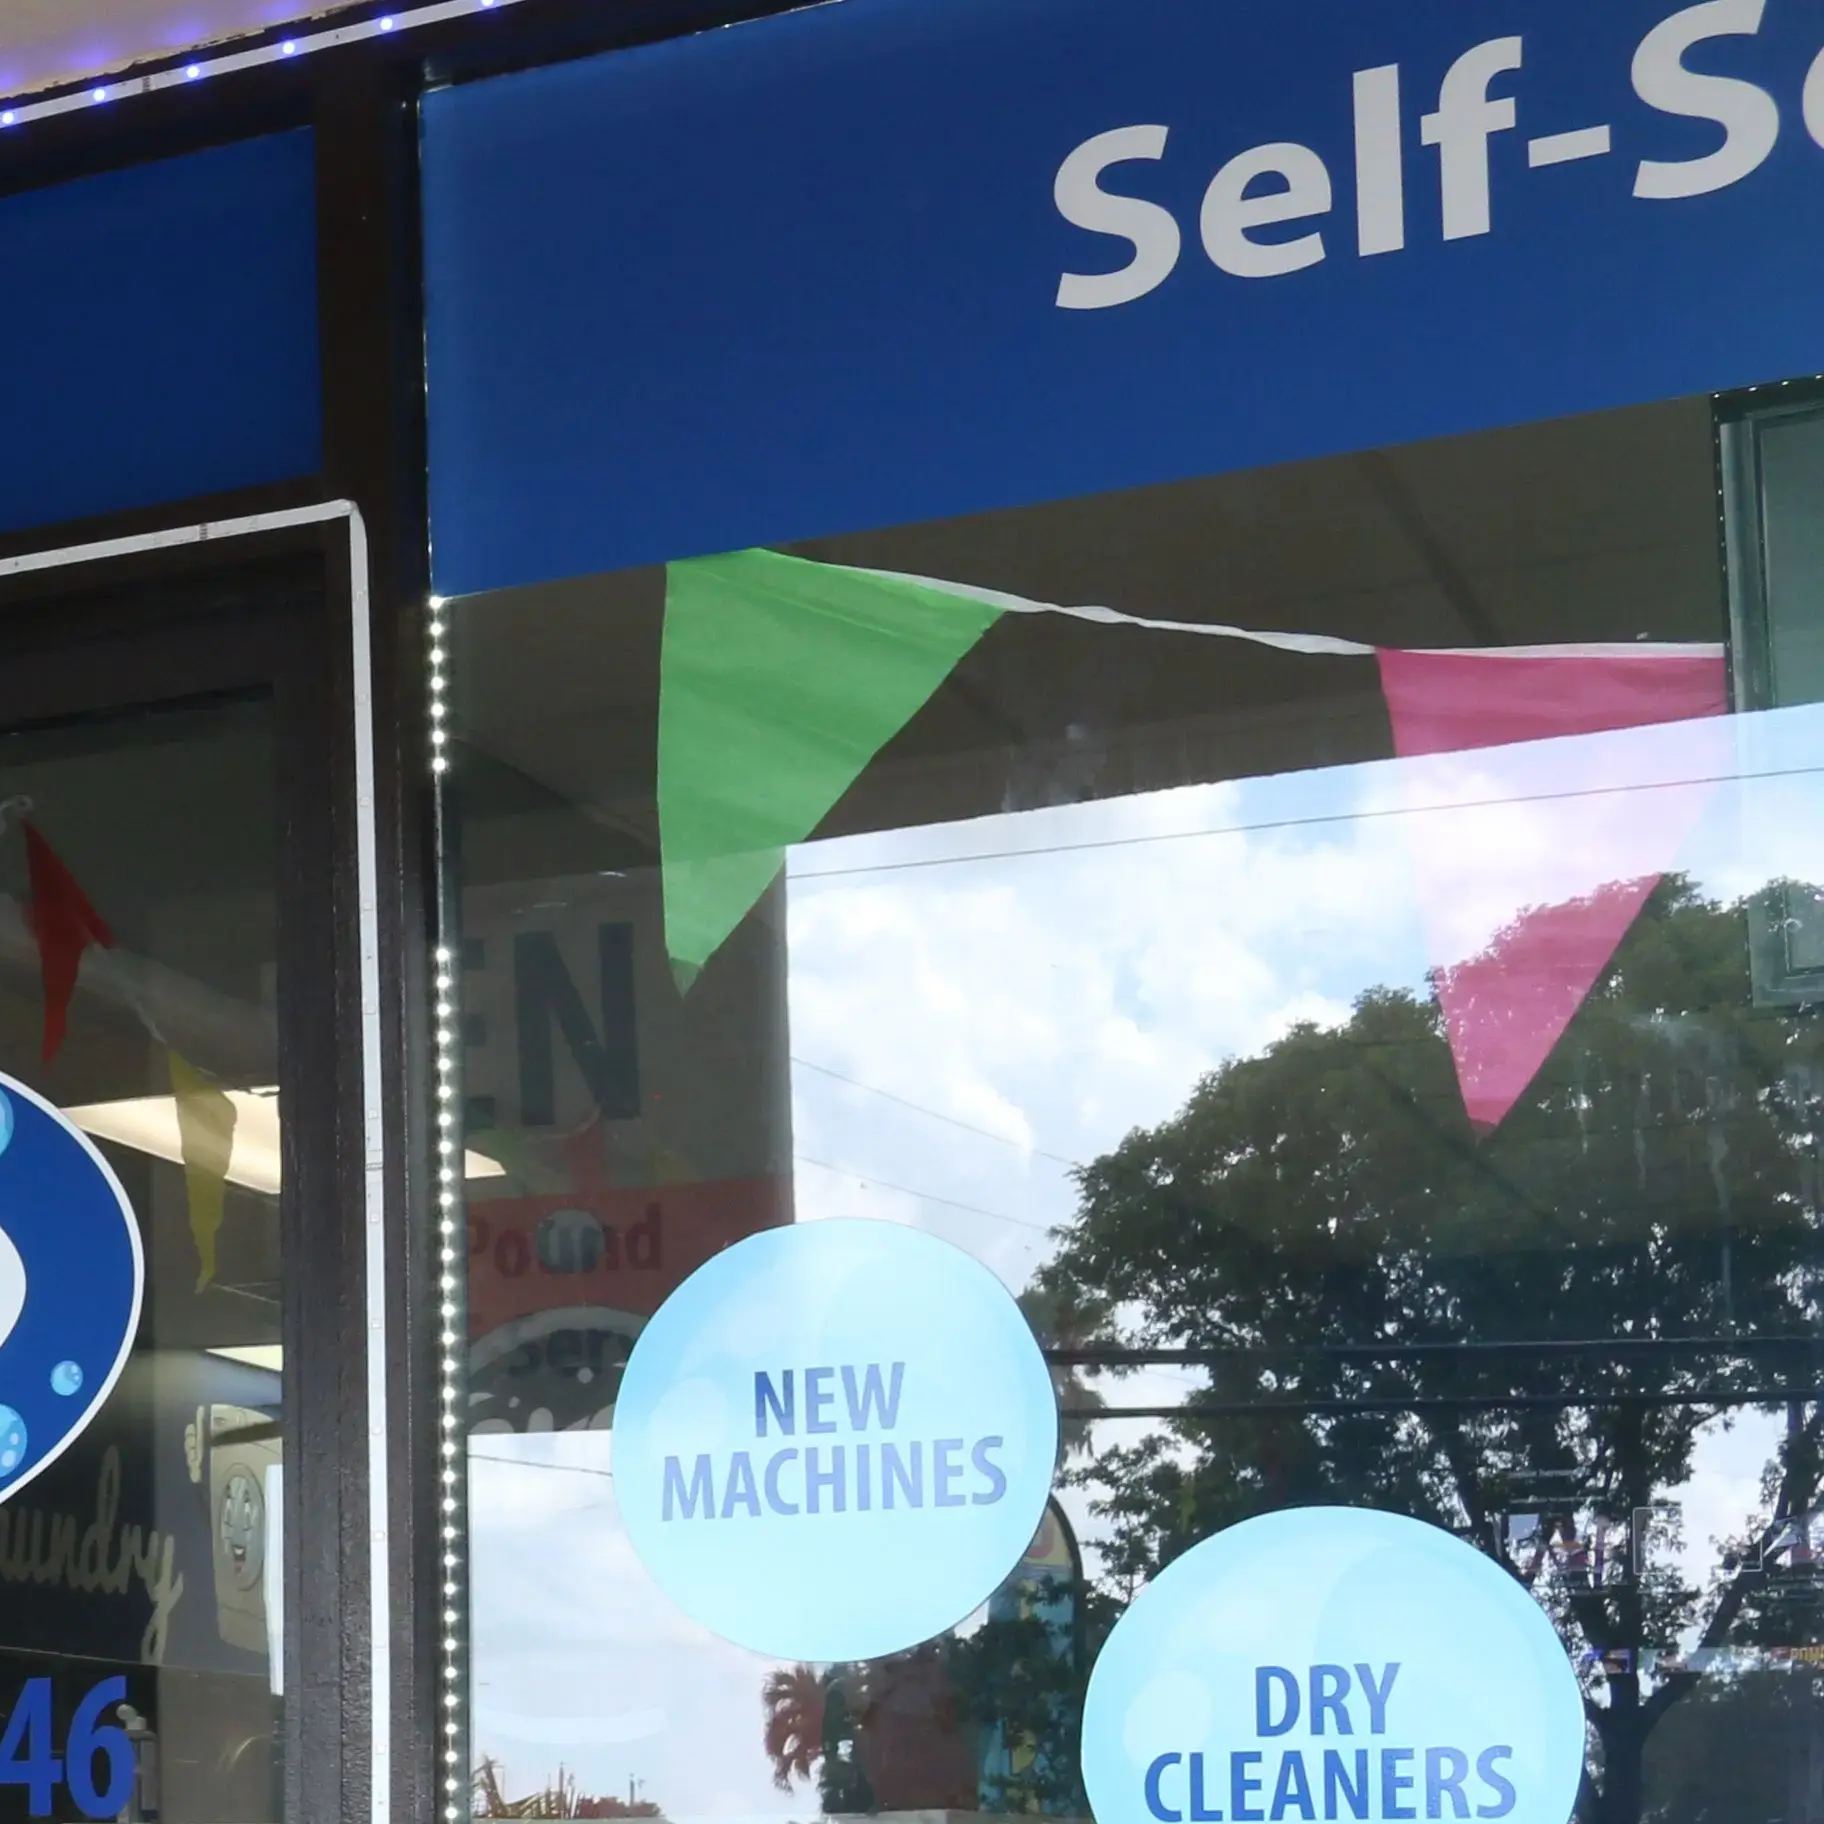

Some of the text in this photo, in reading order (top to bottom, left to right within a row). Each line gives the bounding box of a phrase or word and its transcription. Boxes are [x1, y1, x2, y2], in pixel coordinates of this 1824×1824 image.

[1053, 0, 1824, 310] Self-S
[753, 1361, 906, 1438] NEW
[661, 1434, 1009, 1522] MACHINES
[1254, 1661, 1401, 1737] DRY
[1143, 1744, 1518, 1824] CLEANERS
